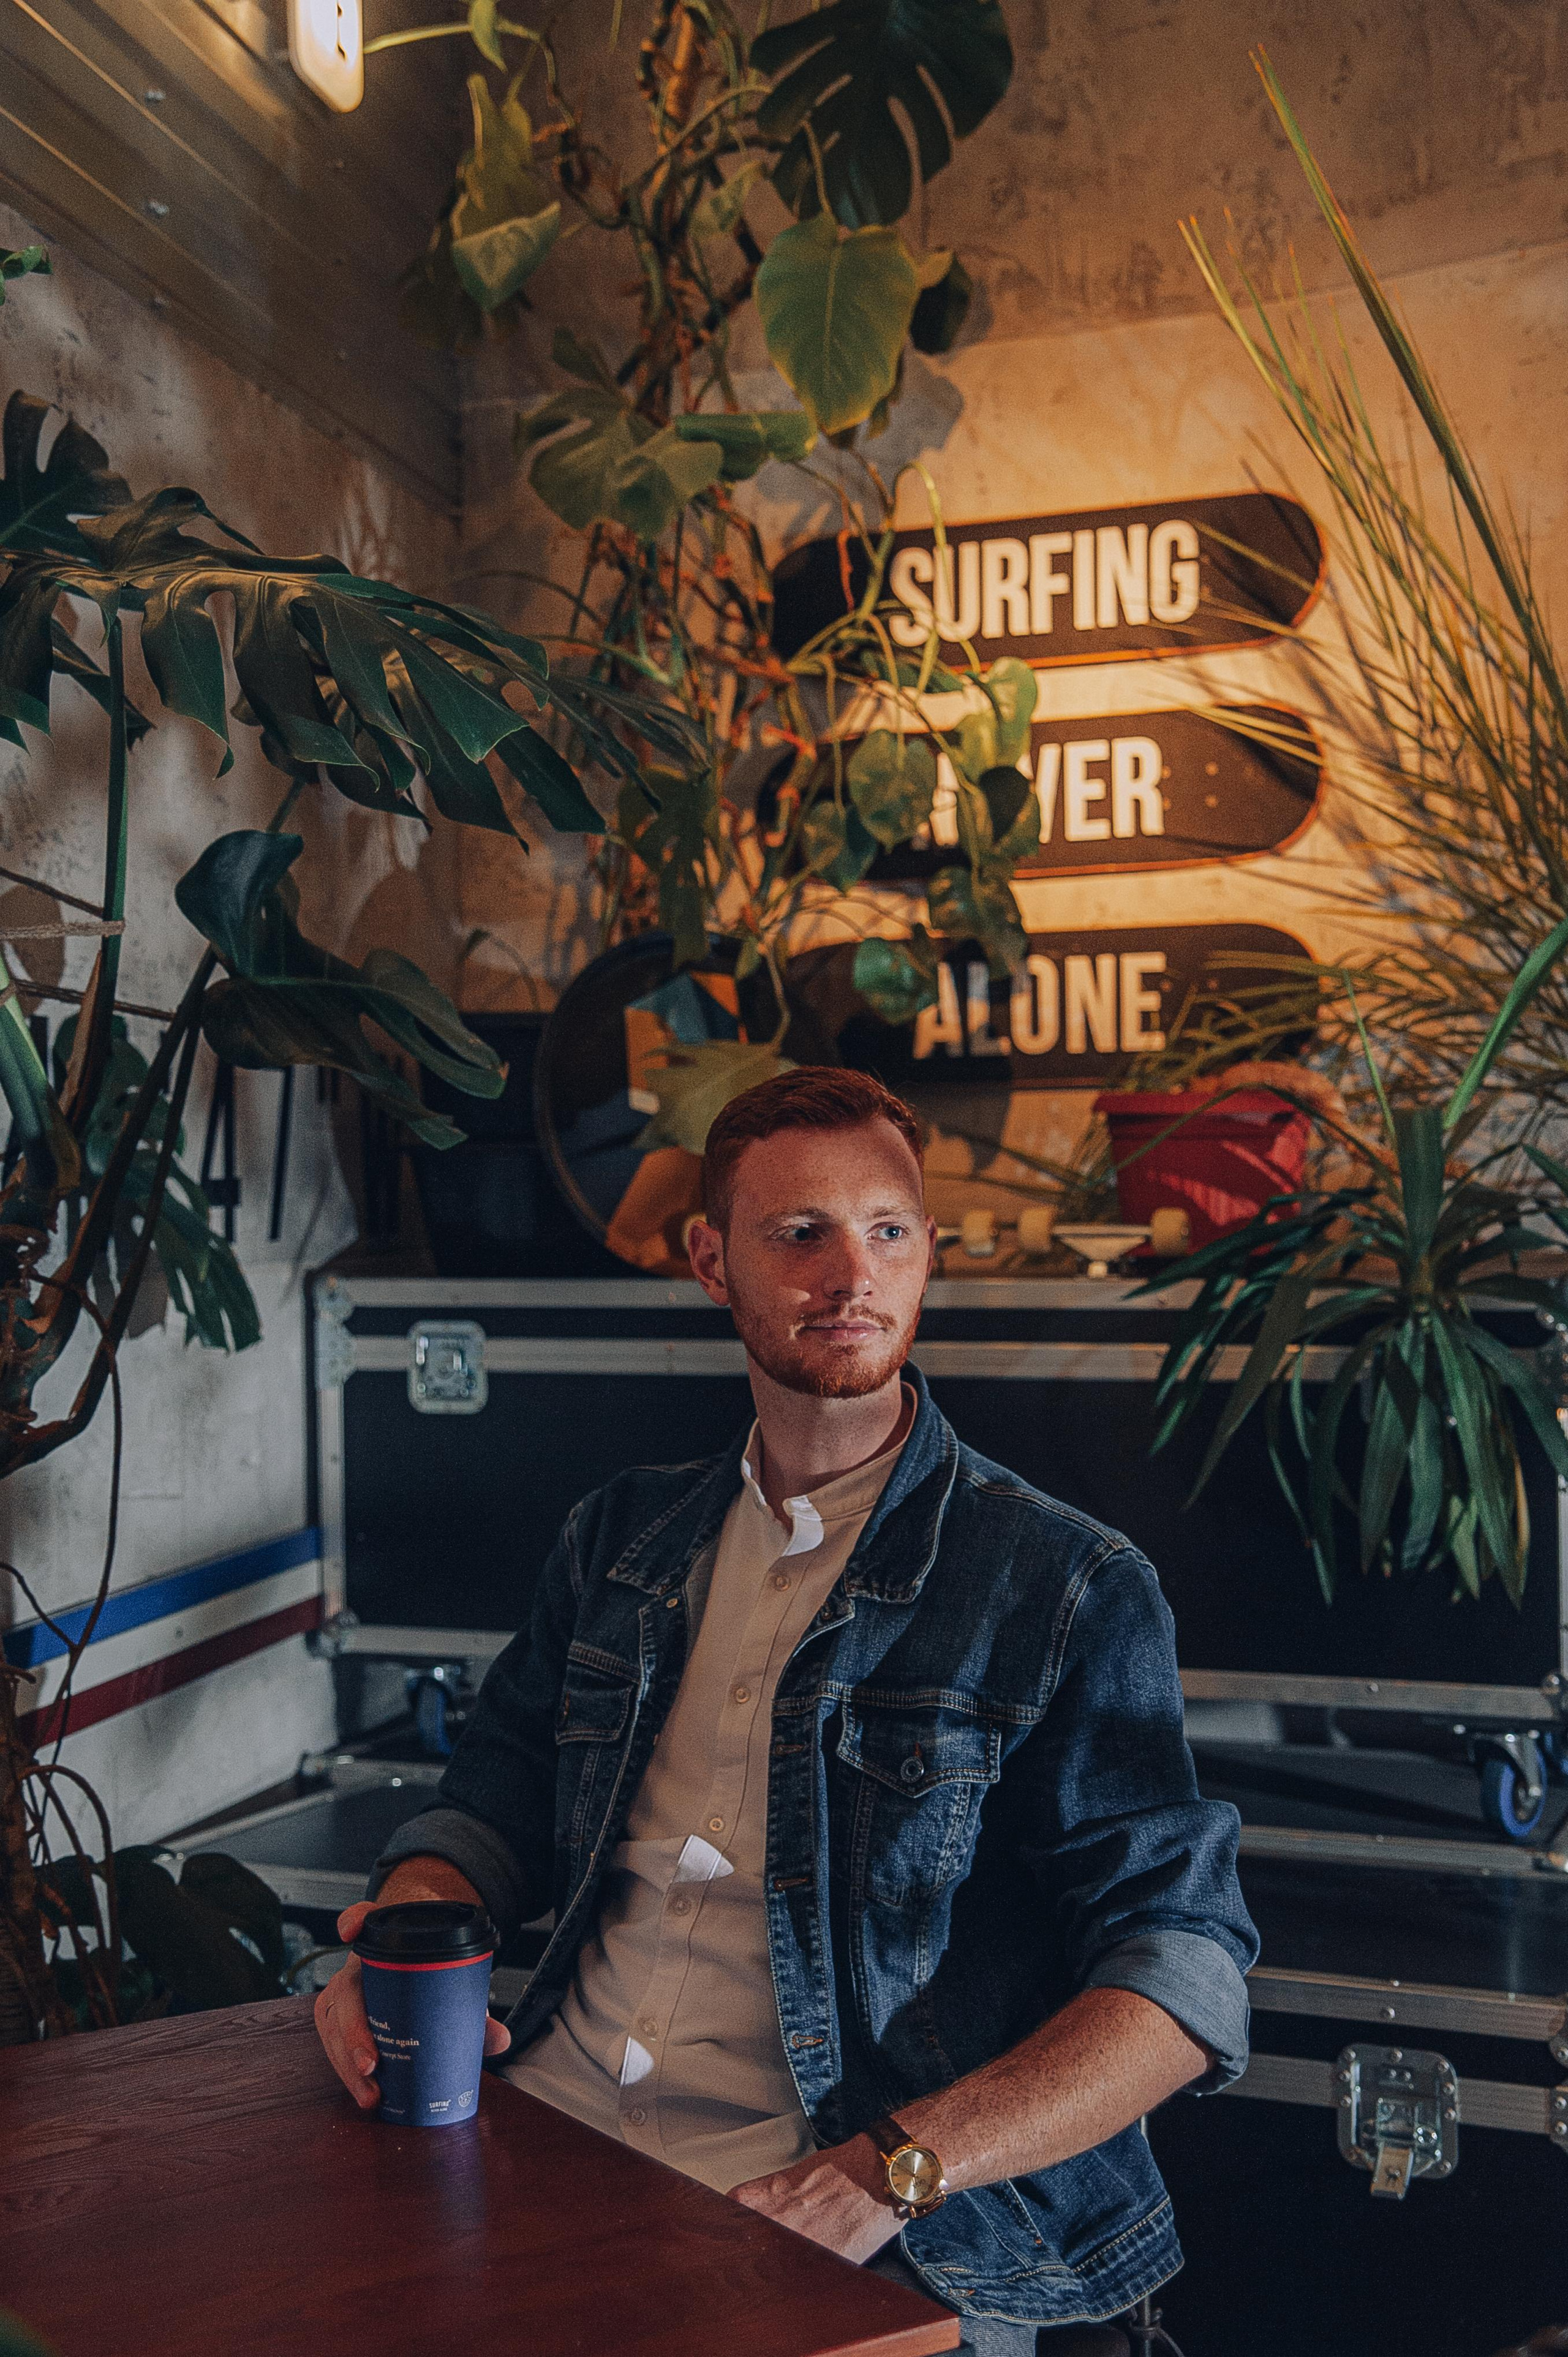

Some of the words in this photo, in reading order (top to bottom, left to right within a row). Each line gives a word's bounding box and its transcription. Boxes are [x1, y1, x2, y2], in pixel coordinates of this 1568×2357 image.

[889, 519, 1200, 648] SURFING
[913, 951, 1167, 1059] ALONE
[377, 2034, 394, 2045] alone
[396, 2038, 420, 2048] again
